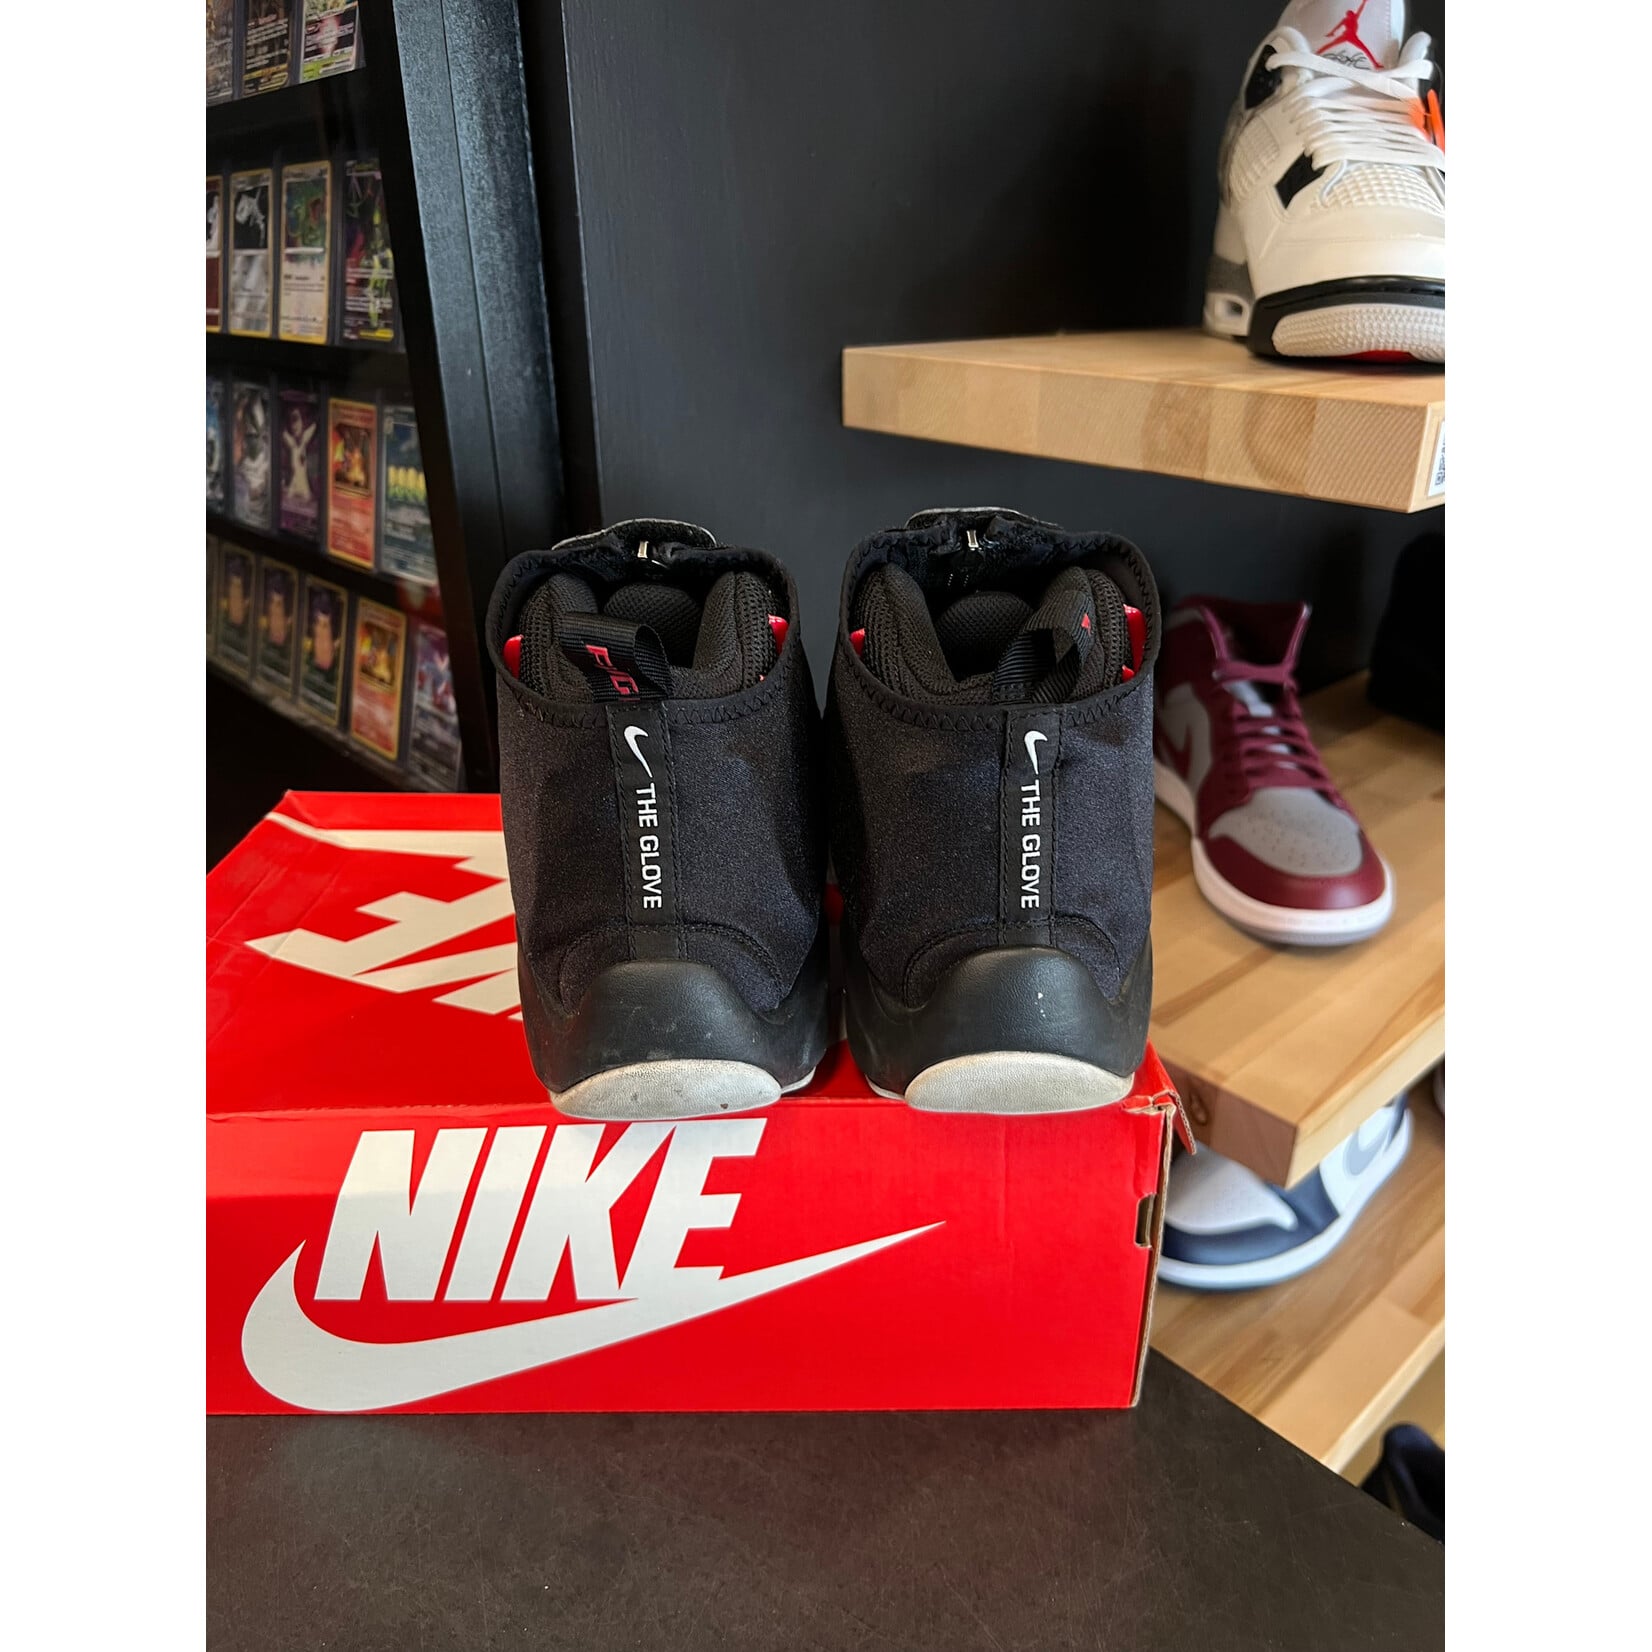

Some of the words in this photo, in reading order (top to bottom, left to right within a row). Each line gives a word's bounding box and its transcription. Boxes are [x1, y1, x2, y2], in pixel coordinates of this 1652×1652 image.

[636, 782, 659, 828] THE
[1020, 779, 1041, 827] THE
[639, 834, 663, 909] GLOVE
[1020, 833, 1041, 909] GLOVE
[313, 1117, 768, 1302] NIKE
